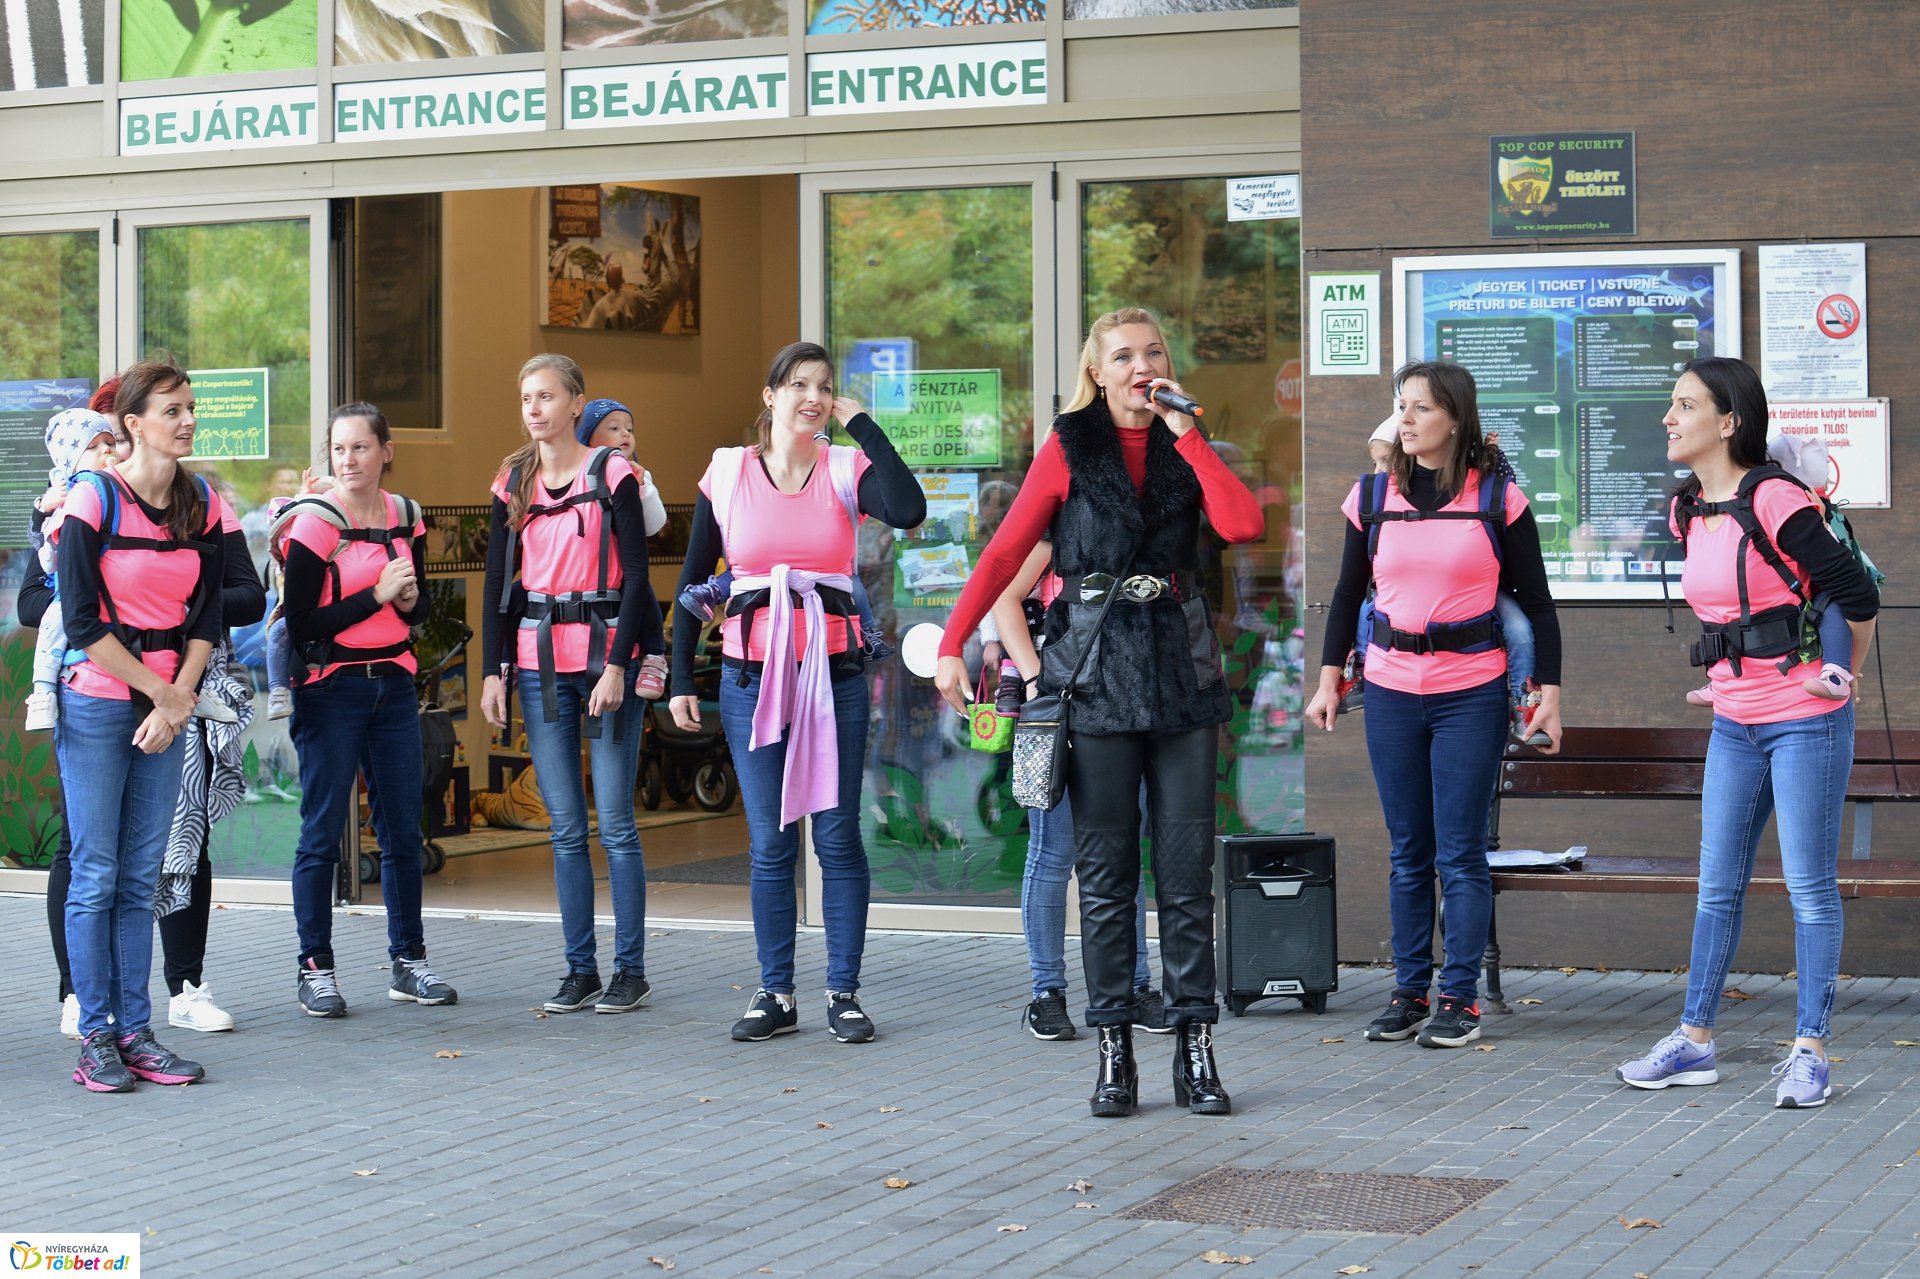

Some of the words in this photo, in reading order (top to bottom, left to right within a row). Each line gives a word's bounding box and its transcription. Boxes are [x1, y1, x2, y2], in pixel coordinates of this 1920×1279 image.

[811, 58, 1046, 106] ENTRANCE
[570, 70, 786, 120] BEJÁRAT
[338, 87, 545, 132] ENTRANCE
[126, 100, 316, 147] BEJÁRAT
[1498, 142, 1524, 152] TOP
[1528, 141, 1555, 151] COP
[1559, 139, 1625, 151] SECURITY
[1565, 169, 1620, 183] ŐRZÖTT
[1559, 184, 1626, 198] TERÜLET!
[1515, 222, 1610, 232] www.topcopsecurity.hu
[1475, 280, 1527, 293] JEGYEK
[1538, 279, 1586, 292] TICKET
[1598, 276, 1660, 290] VSTUPNÉ
[1323, 284, 1365, 301] ATM
[1511, 298, 1527, 309] DE
[1530, 297, 1576, 309] BILETE
[1587, 296, 1624, 308] CENY
[1627, 294, 1687, 308] BILETÓW
[1332, 319, 1357, 329] ATM
[894, 384, 904, 397] A
[909, 378, 978, 396] PÉNZTÁR
[909, 400, 964, 415] NYITVA
[1780, 408, 1819, 419] területére
[1821, 408, 1845, 420] kutyát
[1848, 408, 1877, 418] bevinni
[890, 424, 929, 439] CASH
[934, 423, 984, 439] DESKS
[1823, 423, 1848, 434] TILOS!
[900, 443, 929, 457] ARE
[933, 442, 975, 457] OPEN
